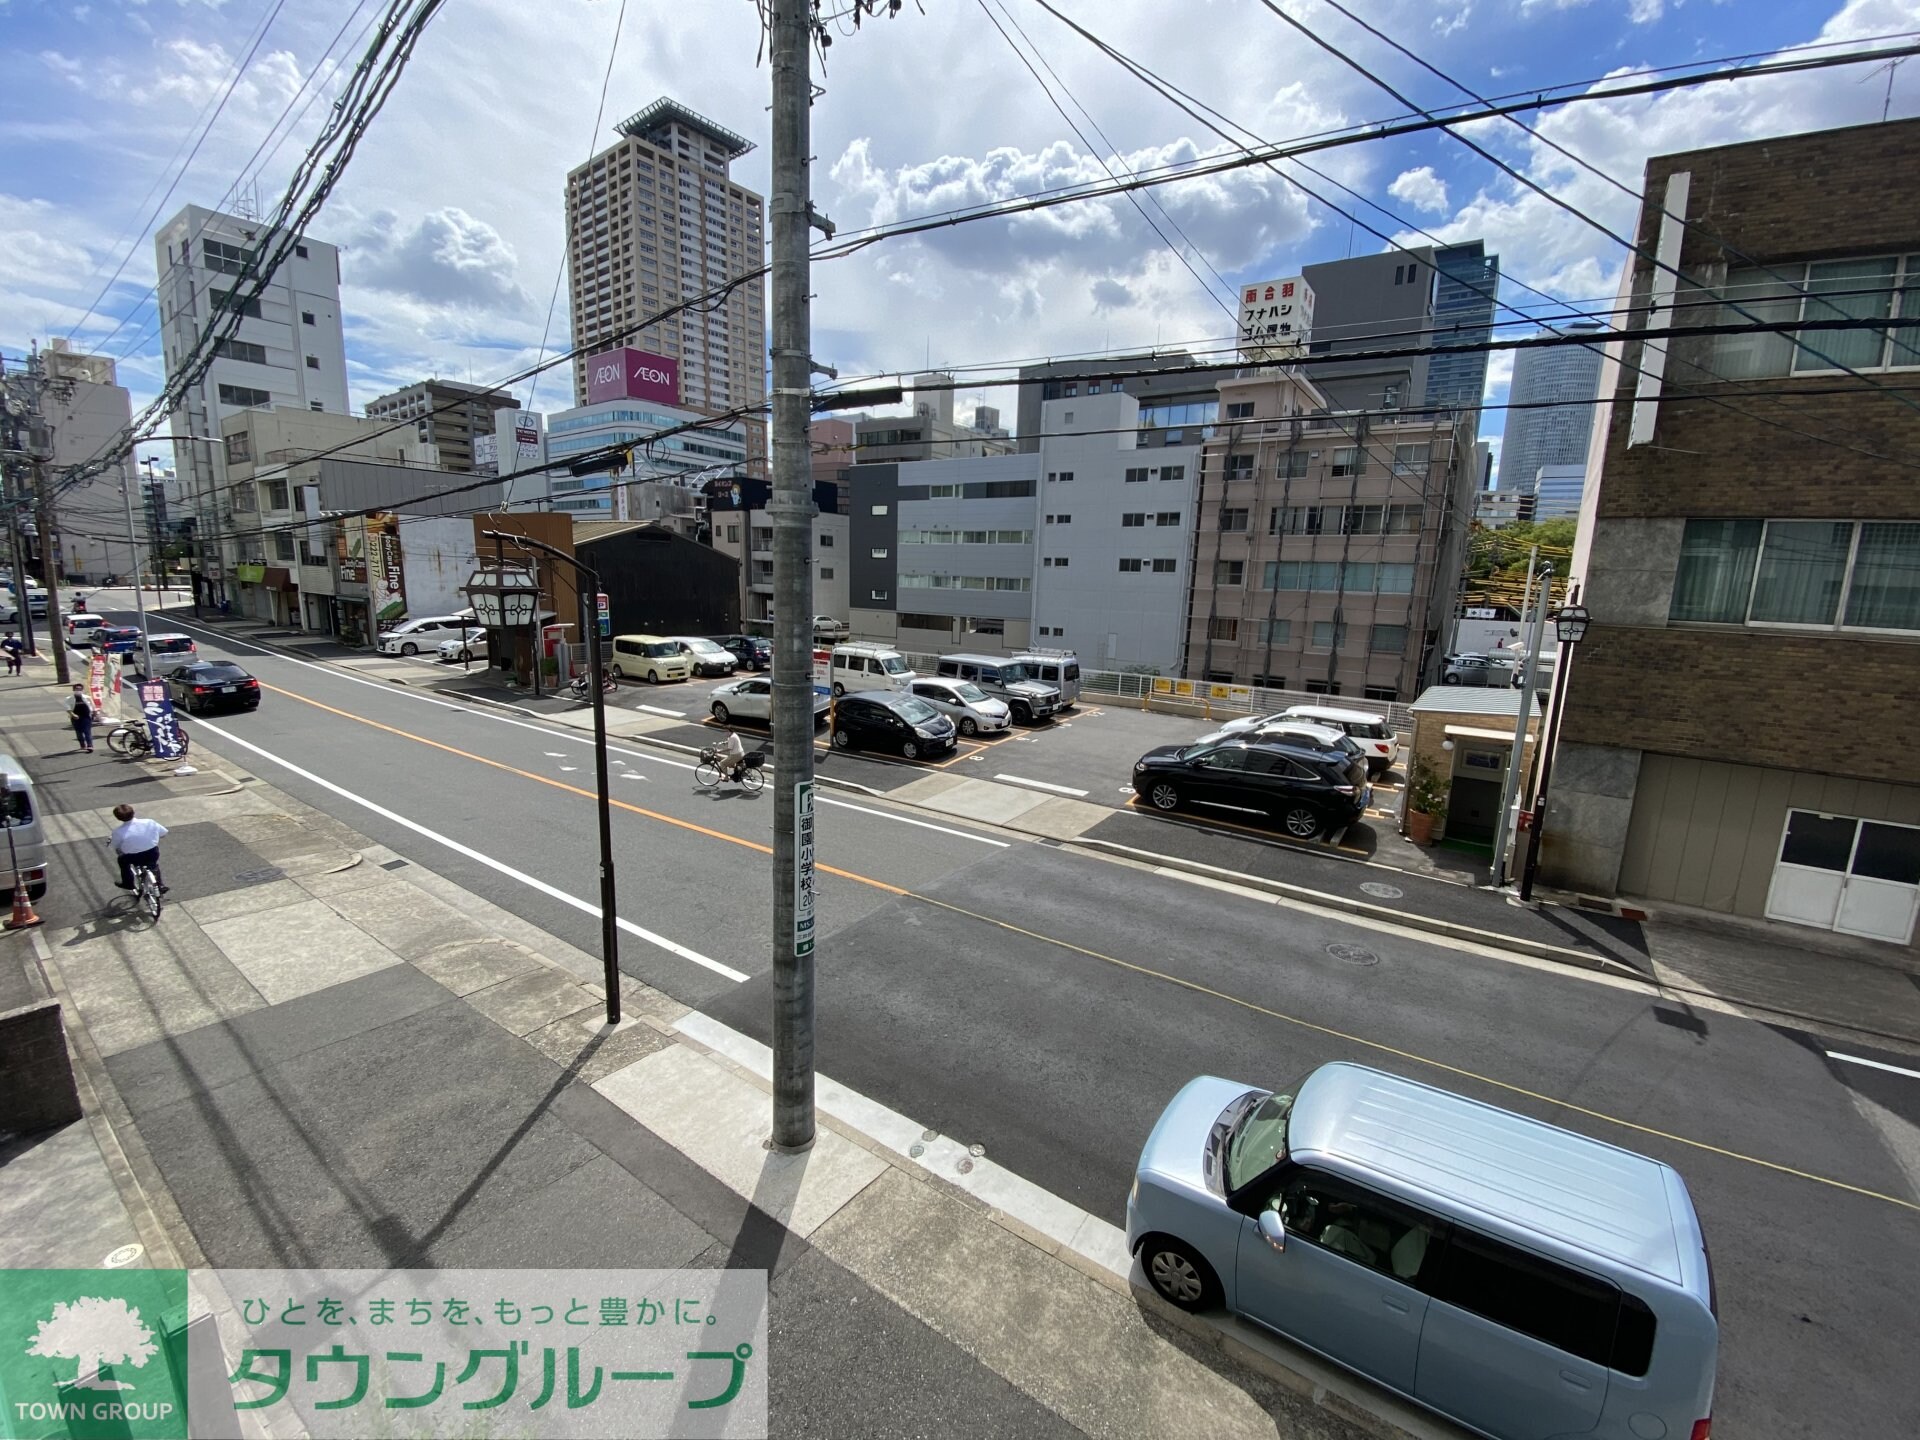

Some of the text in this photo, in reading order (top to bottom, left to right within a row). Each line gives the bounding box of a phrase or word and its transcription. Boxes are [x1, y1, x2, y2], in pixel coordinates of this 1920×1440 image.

[1246, 282, 1295, 304] 雨合羽
[1245, 304, 1293, 322] フナハシ
[369, 541, 381, 578] 222-7177
[388, 566, 401, 590] Fine
[801, 817, 813, 891] 御園小学校
